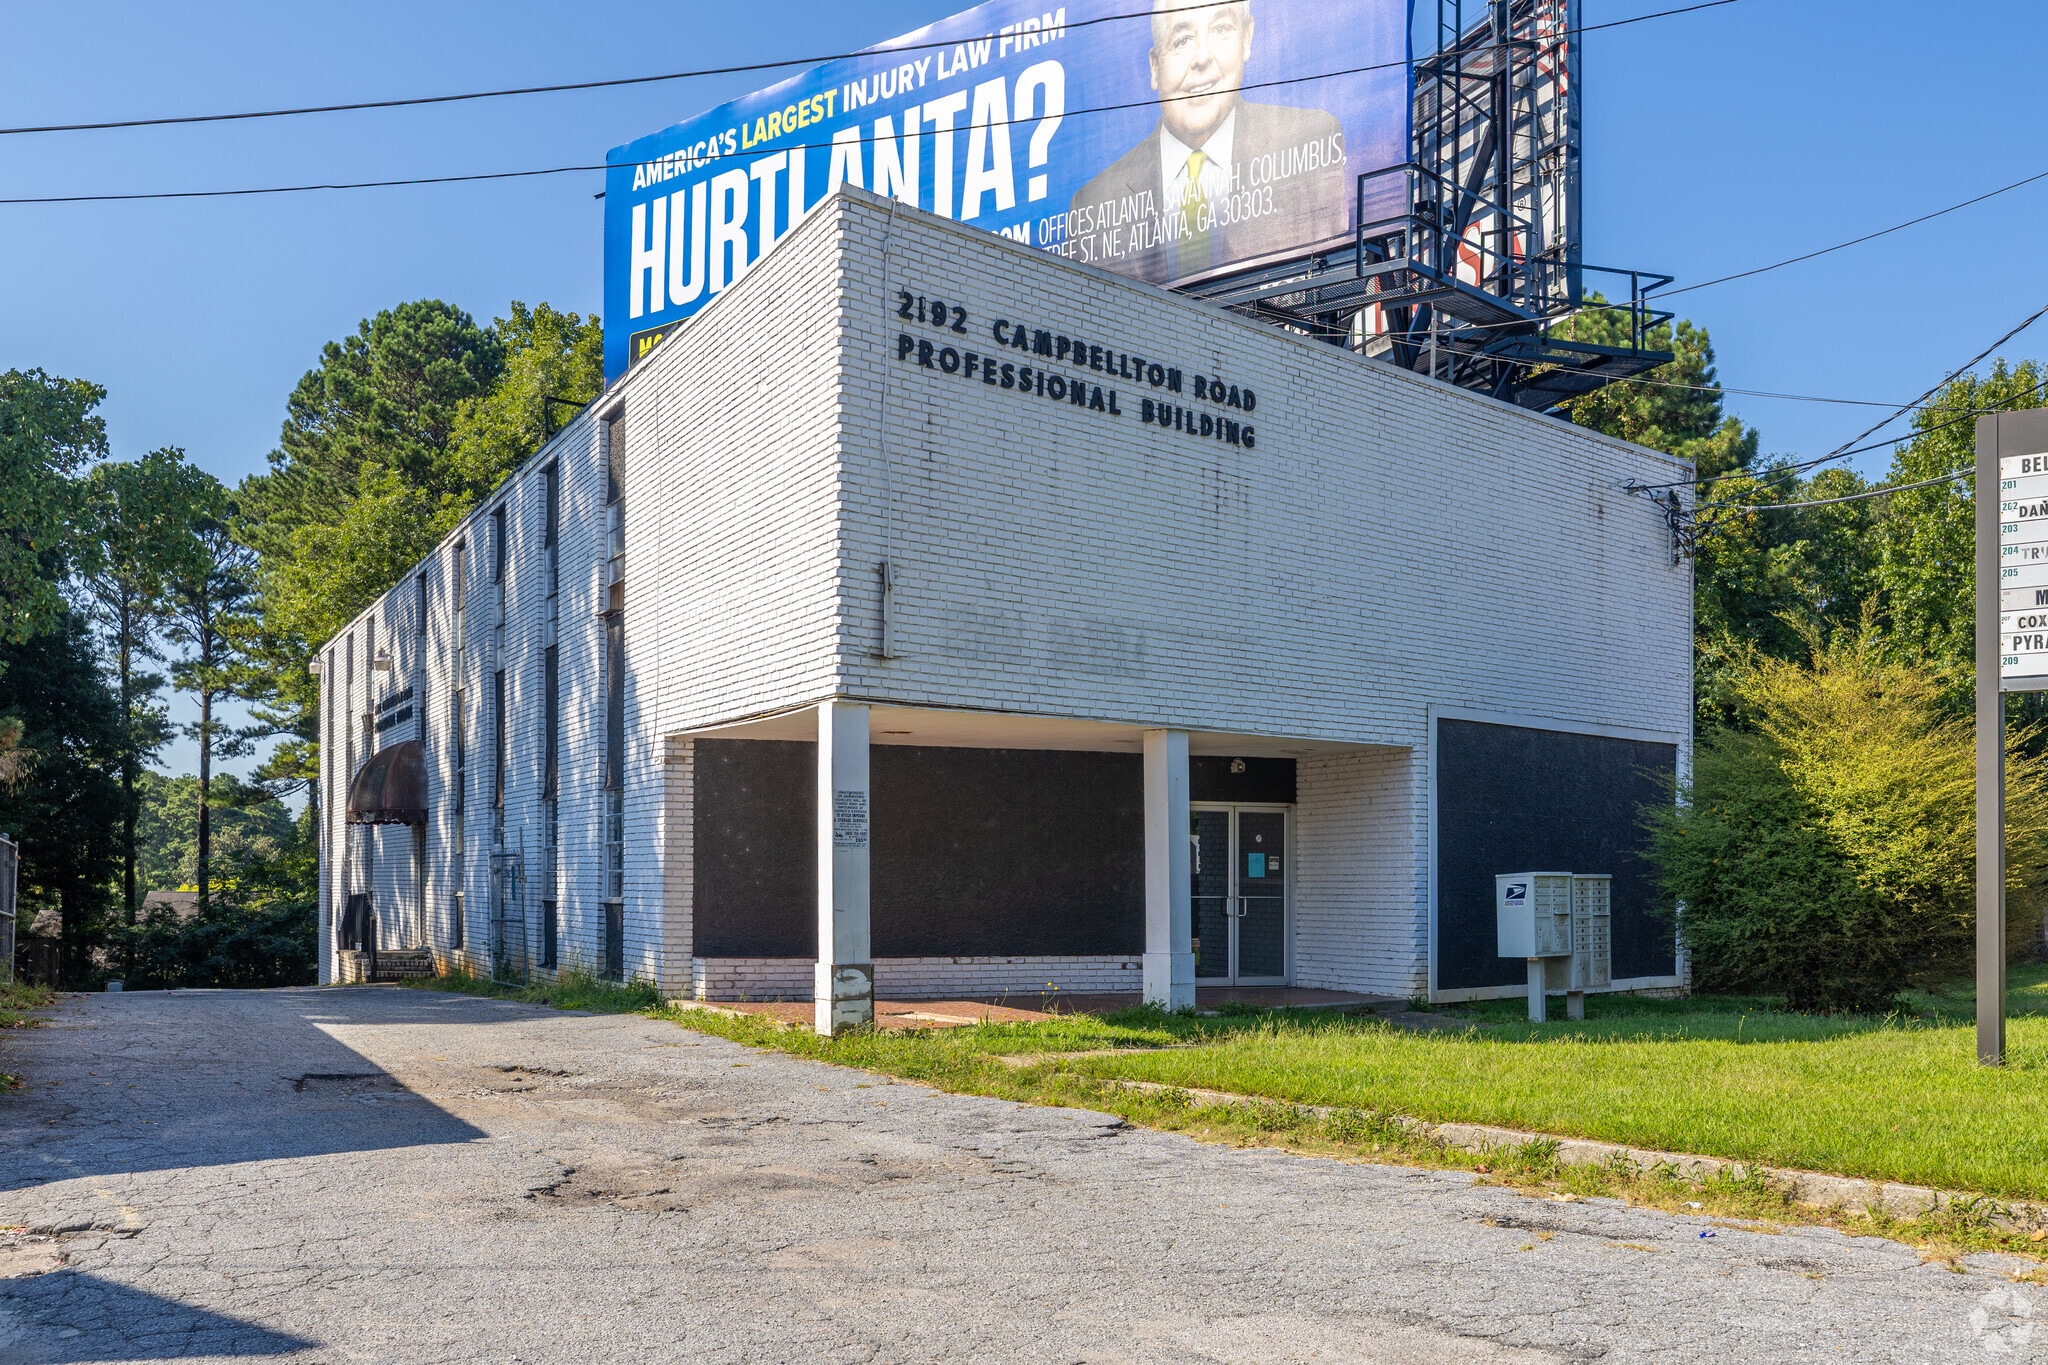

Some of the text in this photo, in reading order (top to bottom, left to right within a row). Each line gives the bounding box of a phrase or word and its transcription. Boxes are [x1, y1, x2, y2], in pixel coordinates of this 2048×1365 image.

[632, 7, 1066, 192] AMERICA'S LARGEST INJURY LAW FIRM
[1038, 132, 1348, 244] OFFICES ATLANTA, SAVANNAH, COLUMBUS,
[1080, 236, 1098, 264] ST.
[1102, 227, 1126, 260] NE,
[1128, 210, 1194, 253] ATLANTA,
[1196, 204, 1218, 233] GA
[1219, 185, 1278, 224] 30303.
[897, 288, 1257, 412] 2192 CAMPBELLTON ROAD
[898, 333, 1256, 448] PROFESSIONAL BUILDING
[2002, 480, 2017, 490] 201
[2002, 502, 2018, 511] 202
[2002, 524, 2018, 534] 203
[2002, 546, 2019, 555] 204
[2002, 568, 2019, 577] 205
[2018, 615, 2048, 629] COX
[2013, 634, 2048, 651] PYR
[2002, 657, 2019, 665] 209
